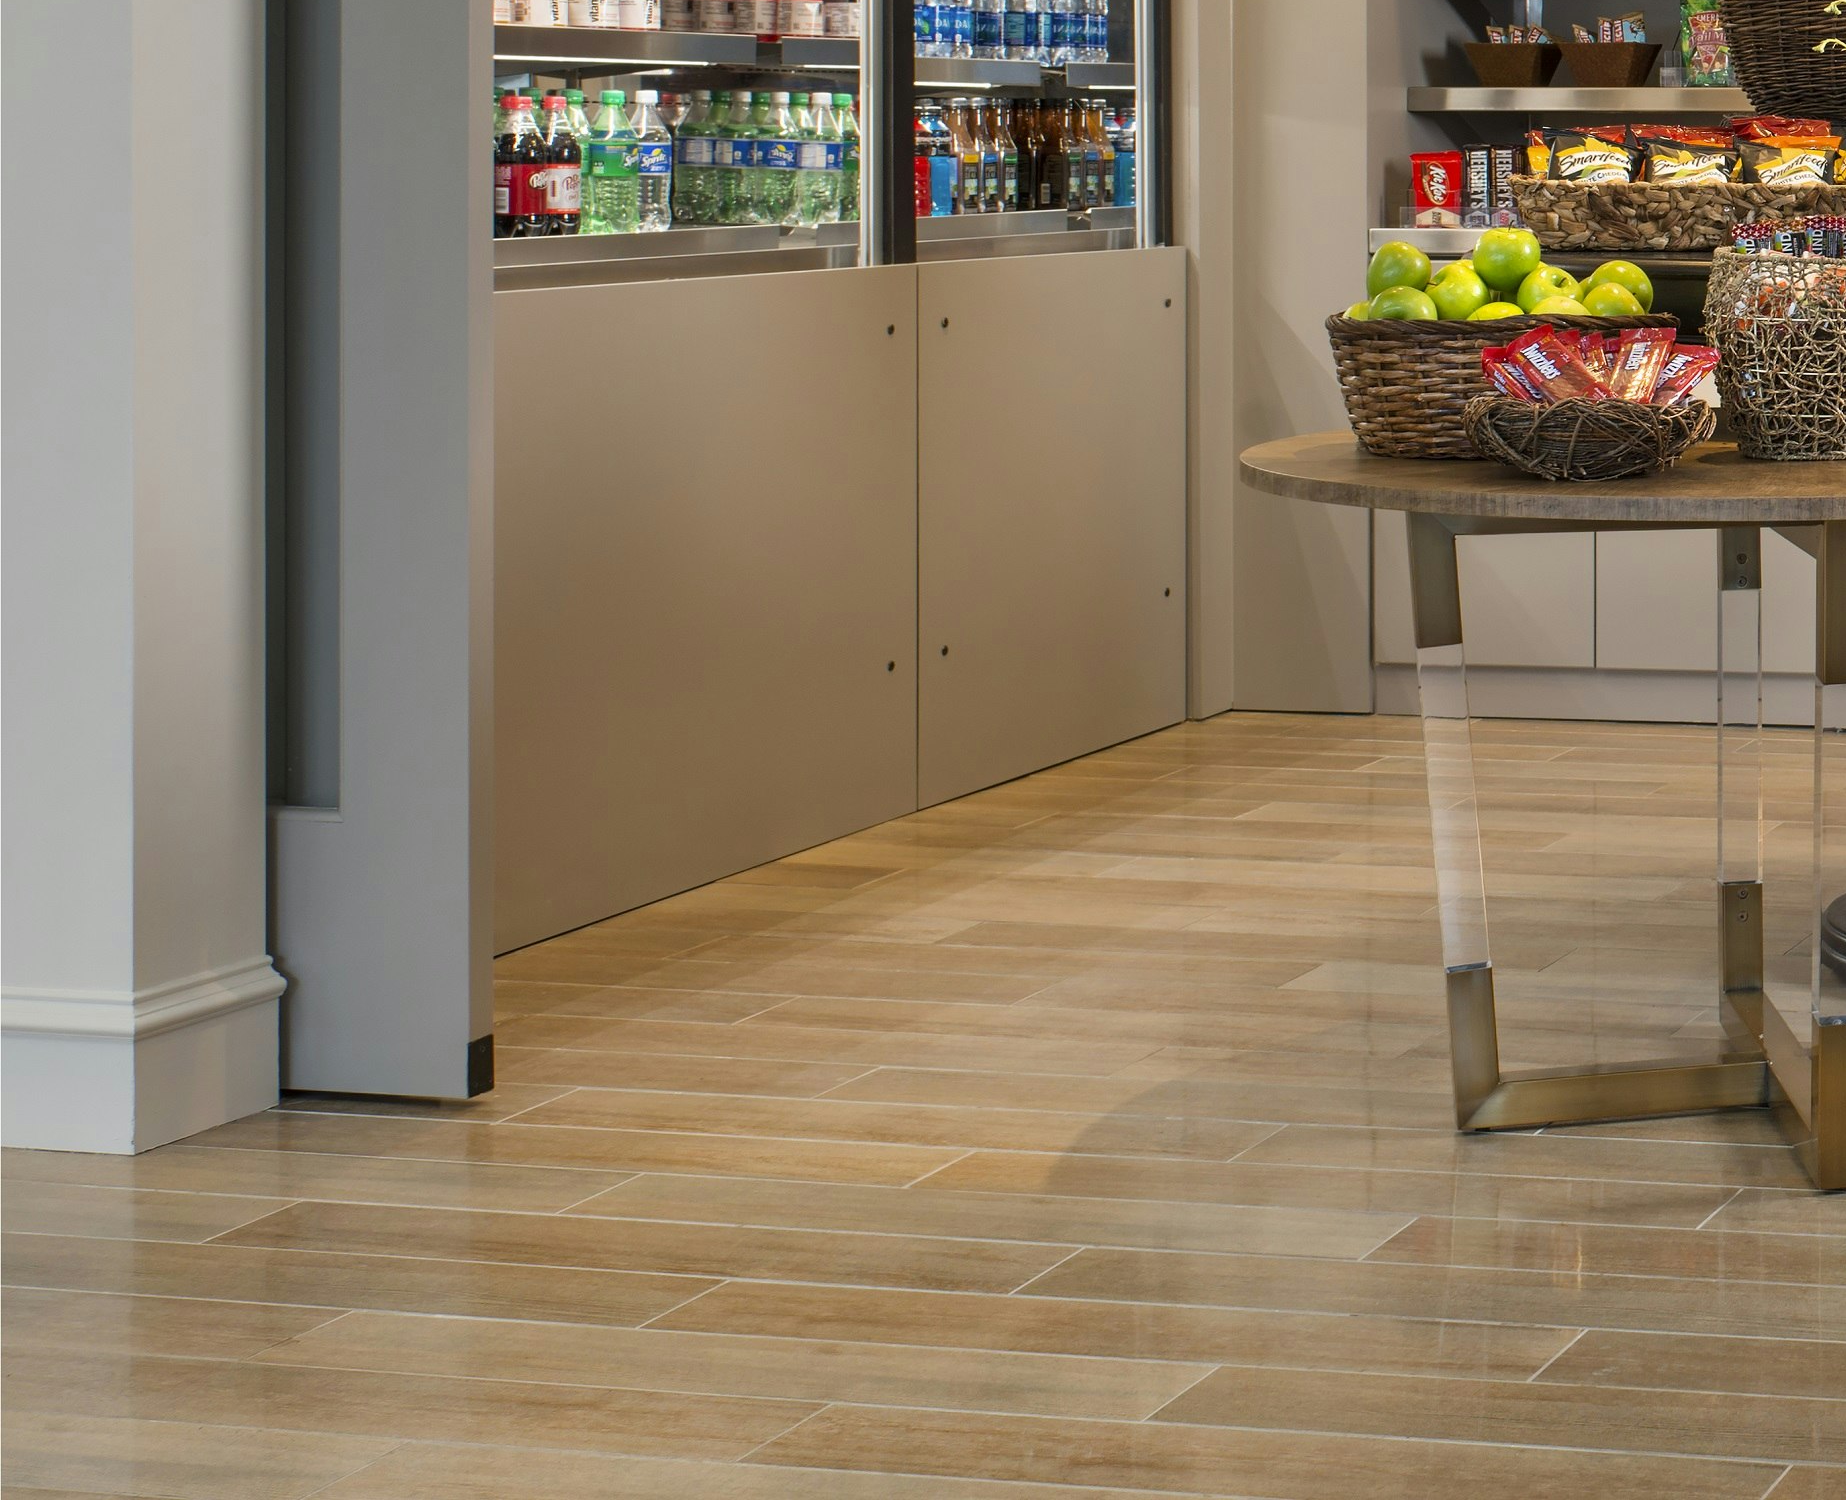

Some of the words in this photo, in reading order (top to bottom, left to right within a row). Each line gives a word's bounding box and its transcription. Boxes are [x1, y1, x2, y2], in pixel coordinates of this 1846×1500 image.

[640, 153, 666, 168] Sprite
[1759, 154, 1828, 182] Smartfood
[1470, 151, 1488, 209] HERSHEY'S
[1520, 343, 1561, 379] Twizzlers
